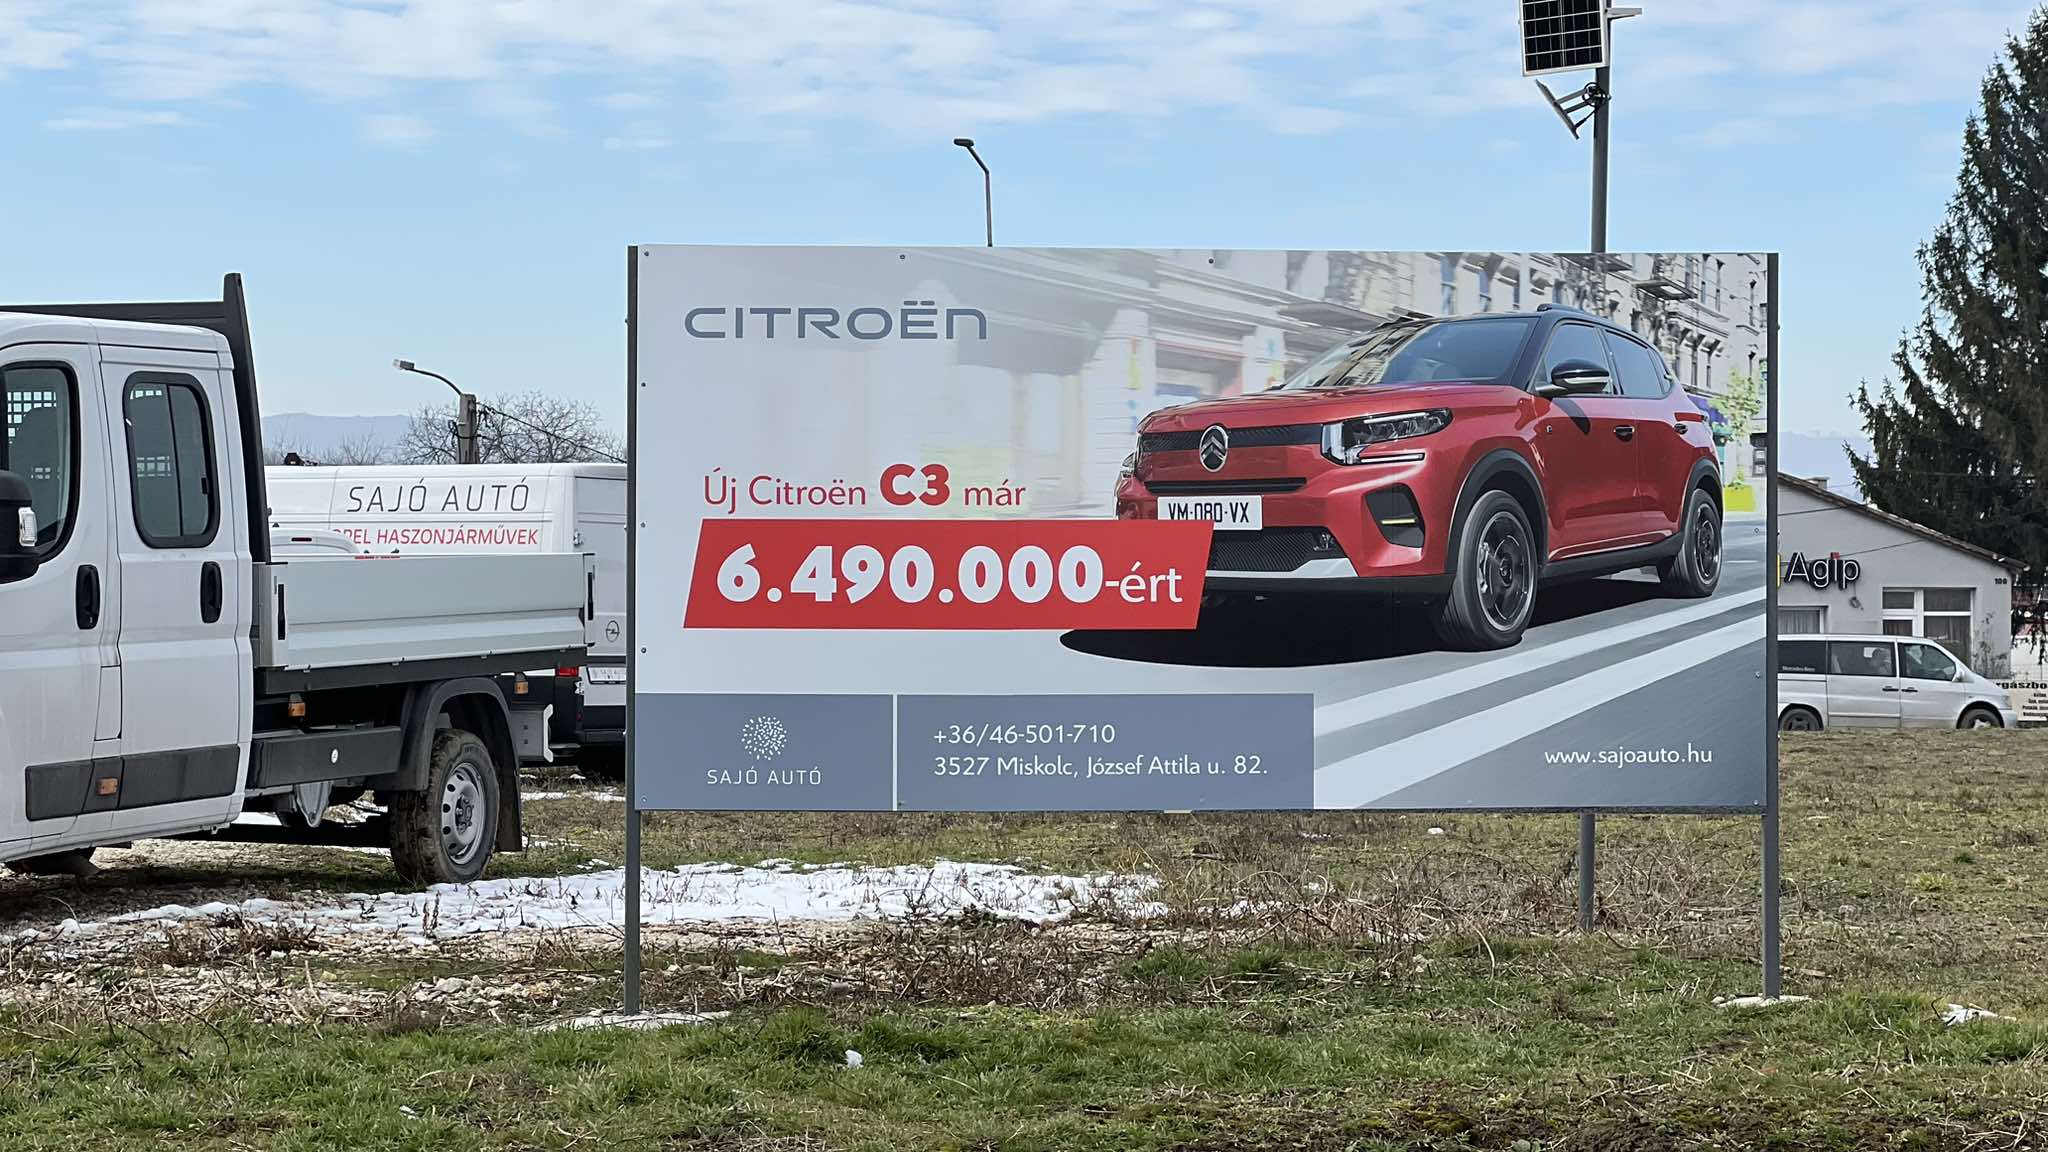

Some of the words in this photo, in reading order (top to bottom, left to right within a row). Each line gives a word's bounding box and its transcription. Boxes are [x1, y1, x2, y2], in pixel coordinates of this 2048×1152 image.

[684, 300, 988, 341] CITROËN
[346, 476, 428, 513] SAJÓ
[441, 475, 530, 512] AUTÓ
[703, 466, 738, 514] Új
[748, 475, 867, 507] Citroën
[878, 463, 951, 507] C3
[962, 482, 1026, 507] már
[376, 524, 539, 545] HASZONJÁRMŰVEK
[716, 543, 1182, 604] 6.490.000-ért
[1784, 551, 1861, 591] Agip
[932, 722, 1116, 748] +36/46-501-710
[933, 755, 989, 777] 3527
[996, 754, 1079, 780] Miskolc,
[1085, 753, 1144, 780] József
[1148, 753, 1201, 775] Attila
[1207, 760, 1226, 775] u.
[1232, 754, 1268, 775] 82.
[1545, 742, 1712, 769] www.sajoauto.hu
[706, 765, 759, 785] SAJÓ
[766, 765, 822, 785] AUTÓ
